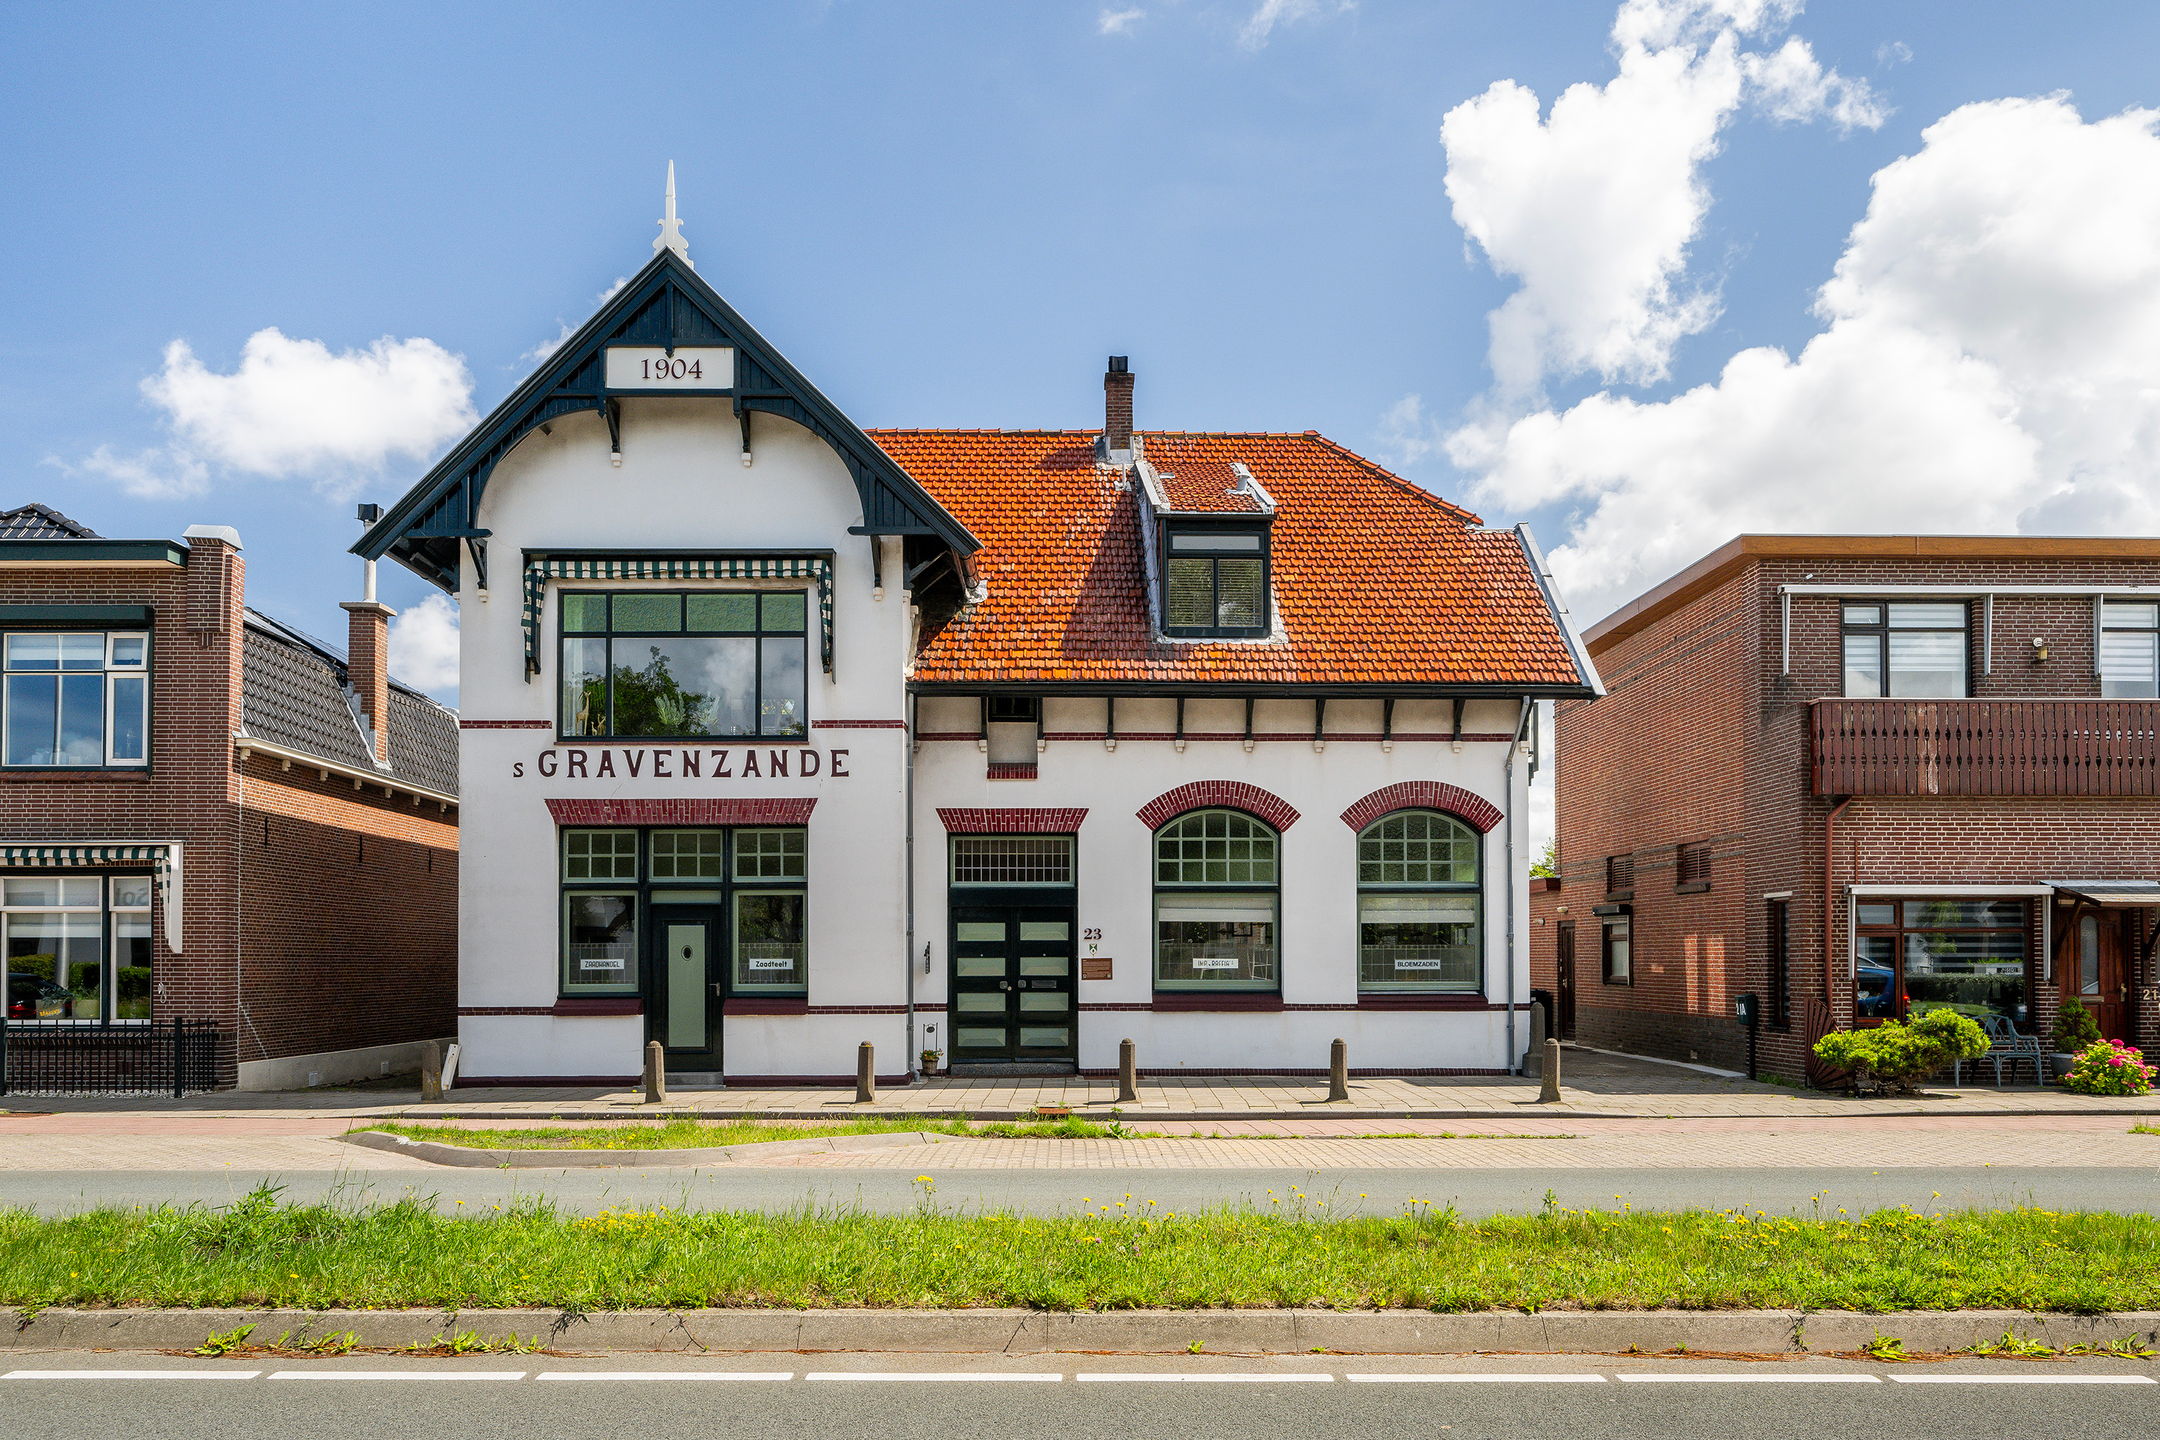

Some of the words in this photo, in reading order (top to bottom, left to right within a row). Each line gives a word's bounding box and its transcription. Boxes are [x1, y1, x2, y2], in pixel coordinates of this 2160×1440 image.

[641, 358, 703, 380] 1904
[538, 749, 850, 778] GRAVENZANDE
[1083, 927, 1102, 940] 23
[755, 960, 787, 968] Zaadteelt
[2143, 989, 2157, 1000] 21
